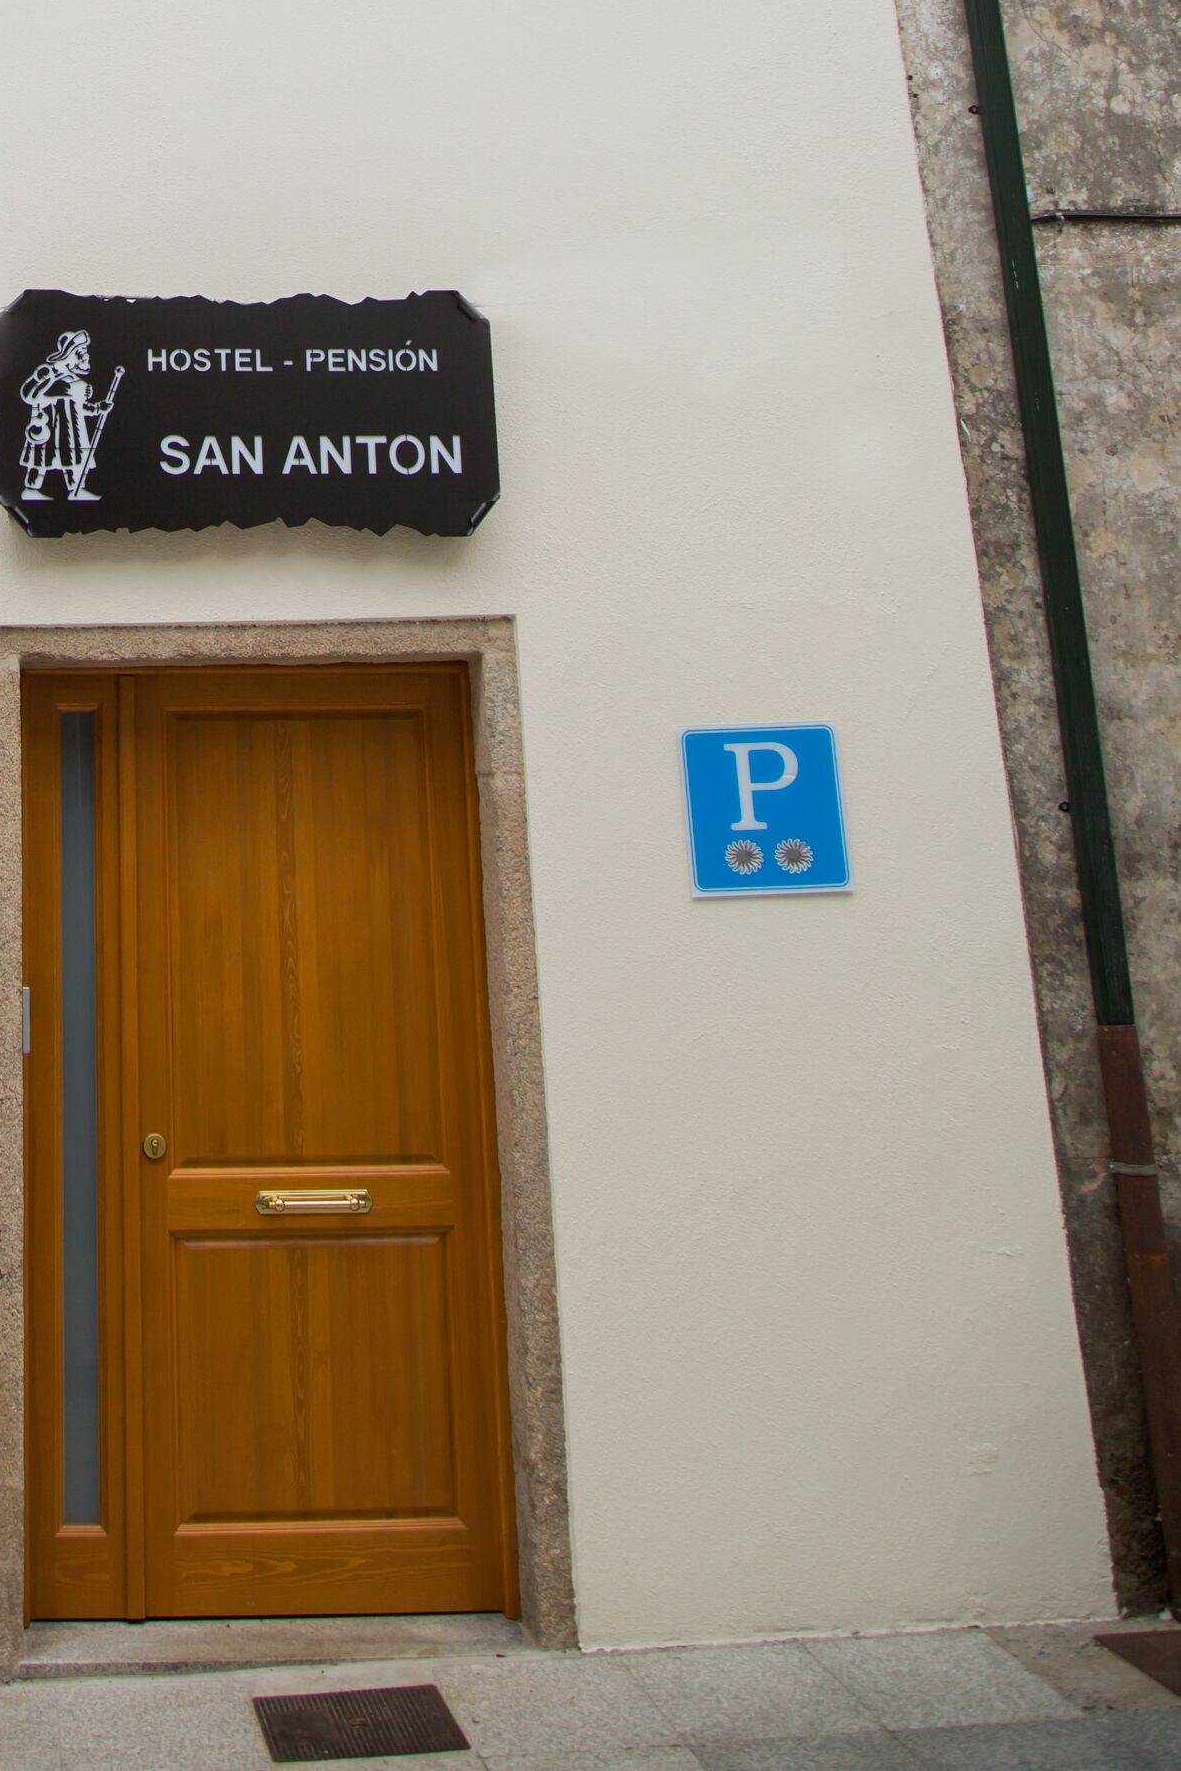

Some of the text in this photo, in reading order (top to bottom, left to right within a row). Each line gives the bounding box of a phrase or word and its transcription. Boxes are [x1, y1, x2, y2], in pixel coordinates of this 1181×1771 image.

[147, 348, 273, 372] HOSTEL
[305, 340, 439, 372] PENSIÓN
[159, 434, 463, 475] SAN ANTON
[723, 741, 799, 831] P
